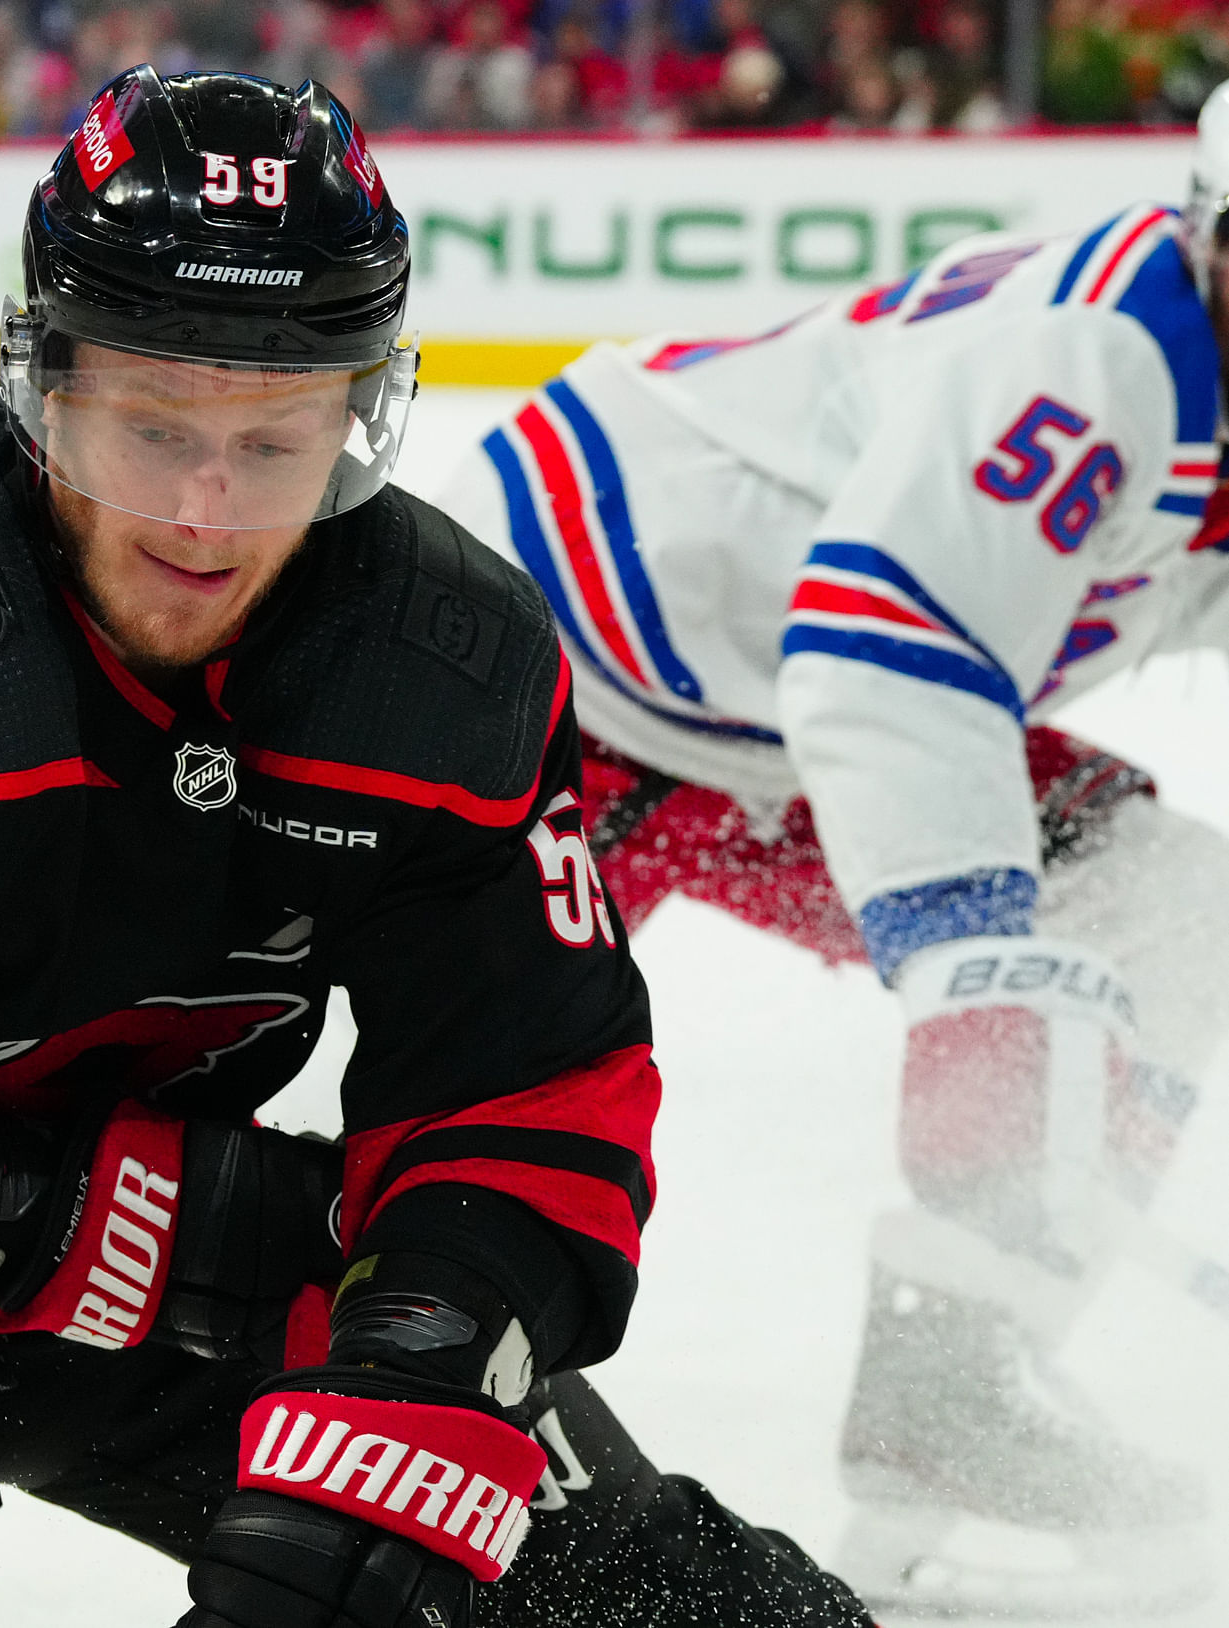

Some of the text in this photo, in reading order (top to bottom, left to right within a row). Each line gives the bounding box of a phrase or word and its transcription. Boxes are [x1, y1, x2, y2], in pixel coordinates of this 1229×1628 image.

[83, 101, 114, 172] Lenovo
[204, 152, 288, 208] 59
[175, 262, 304, 287] WARRIOR
[973, 394, 1125, 556] 56
[187, 763, 225, 795] NHL
[238, 803, 378, 849] NUCOR
[53, 1170, 90, 1263] LEMIEUX
[249, 1404, 532, 1578] WARRI
